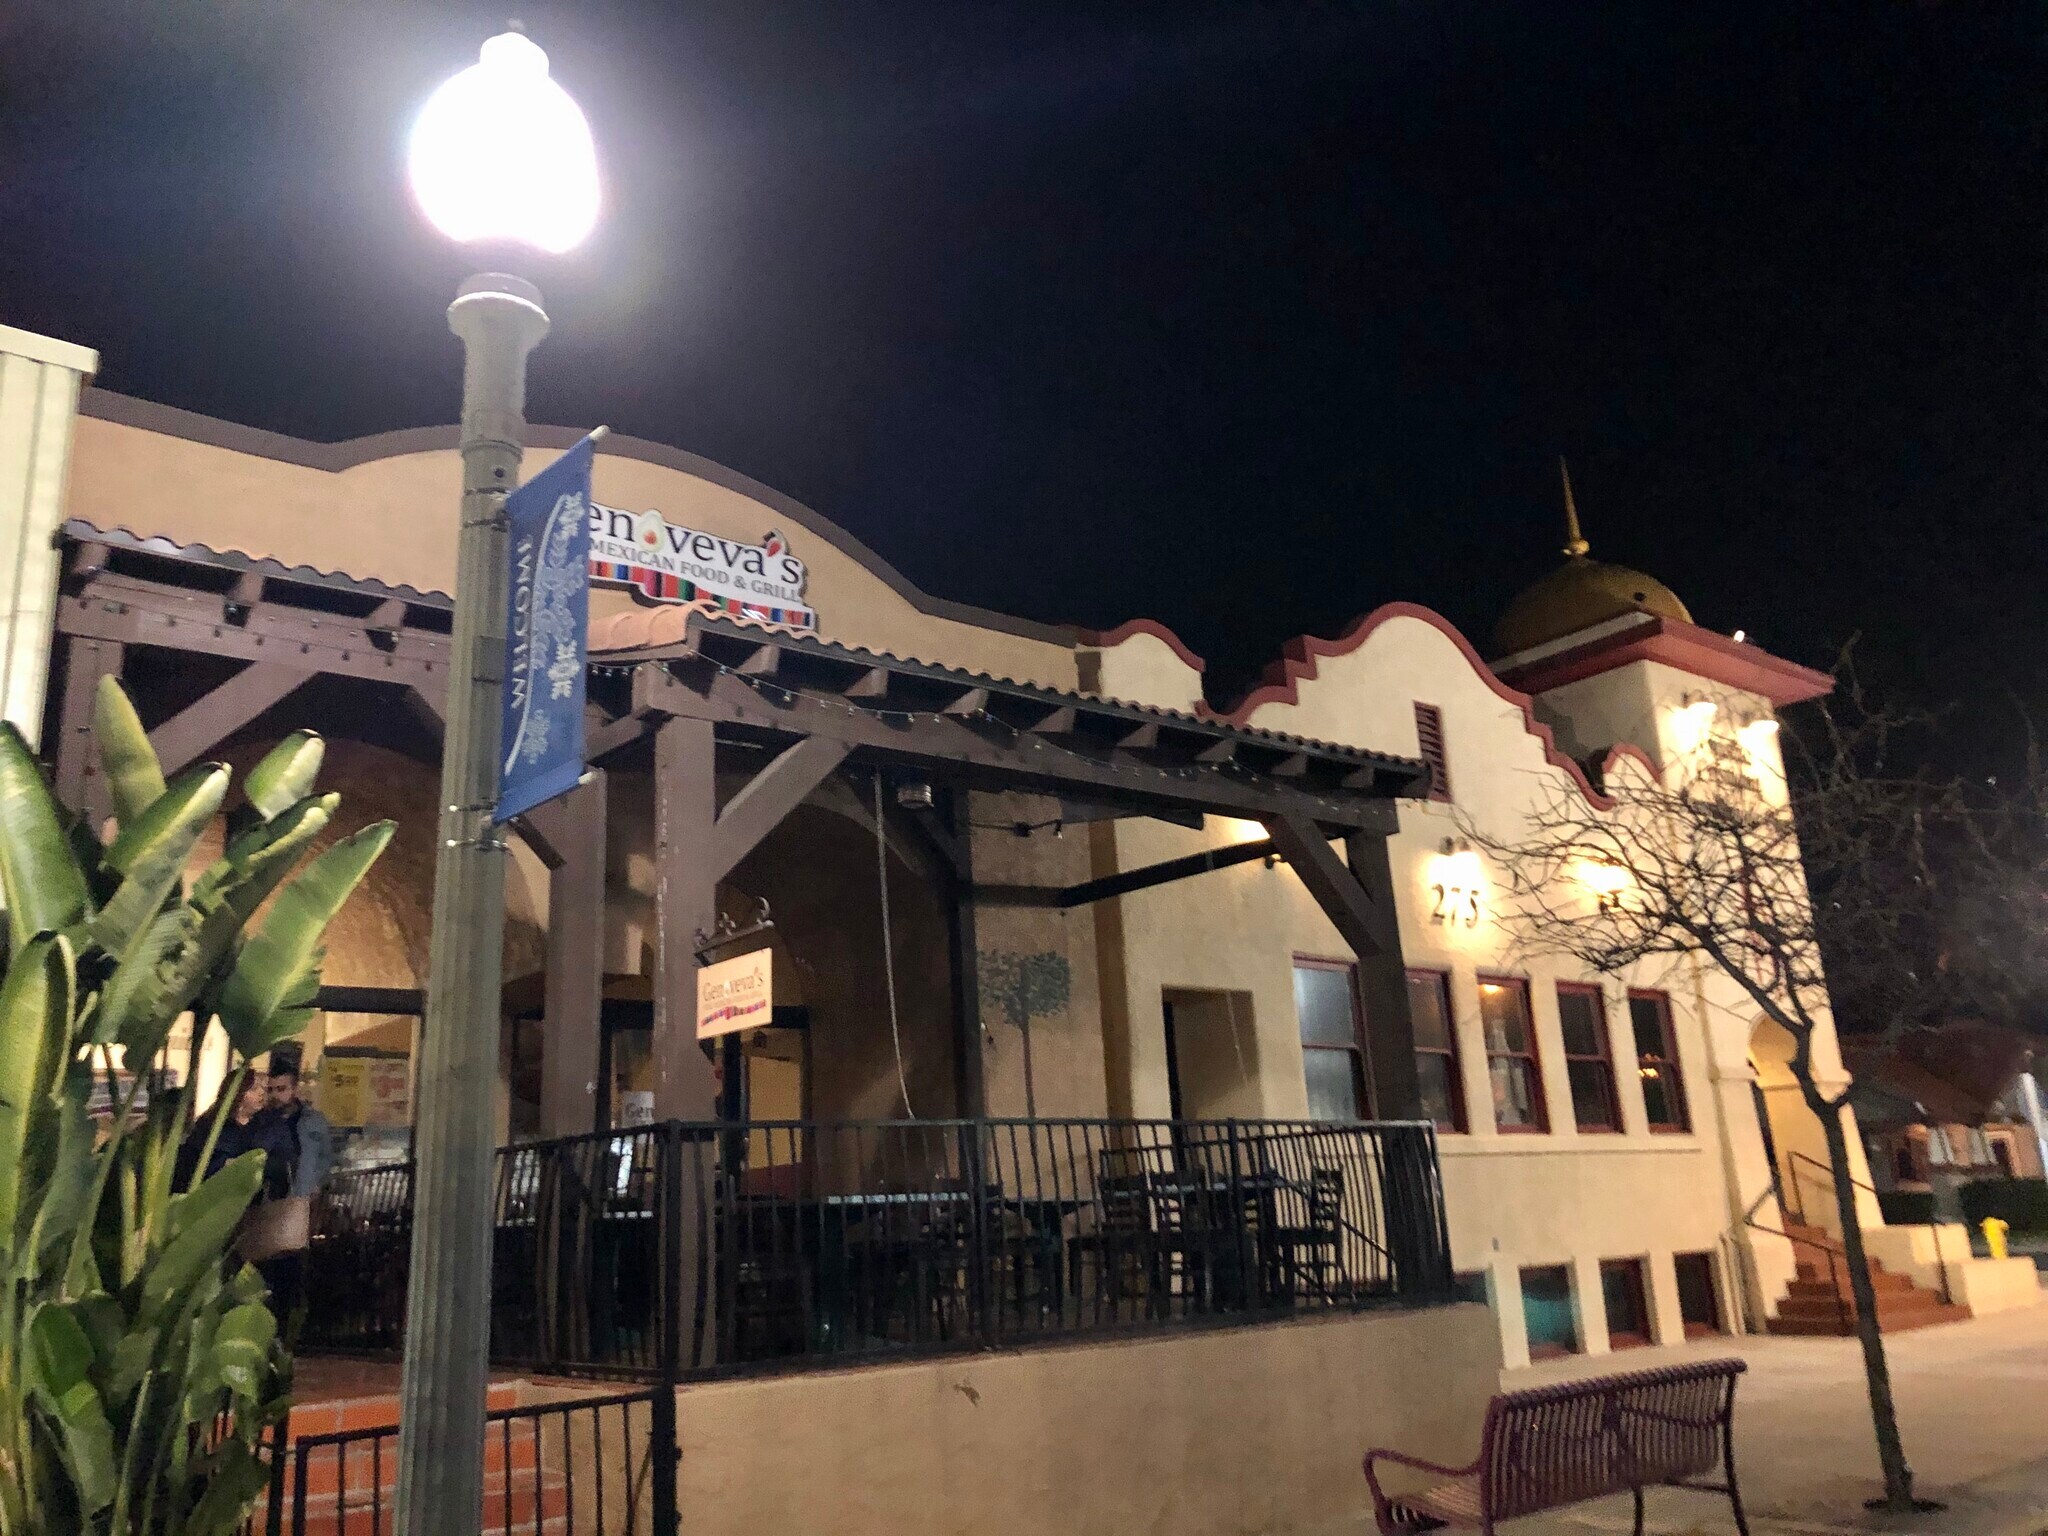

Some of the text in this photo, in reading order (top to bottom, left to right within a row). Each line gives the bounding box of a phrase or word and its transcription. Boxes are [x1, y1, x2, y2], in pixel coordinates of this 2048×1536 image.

[590, 538, 675, 571] MEXICAN
[681, 561, 729, 585] FOOD
[734, 575, 746, 589] &
[1431, 884, 1479, 929] 275
